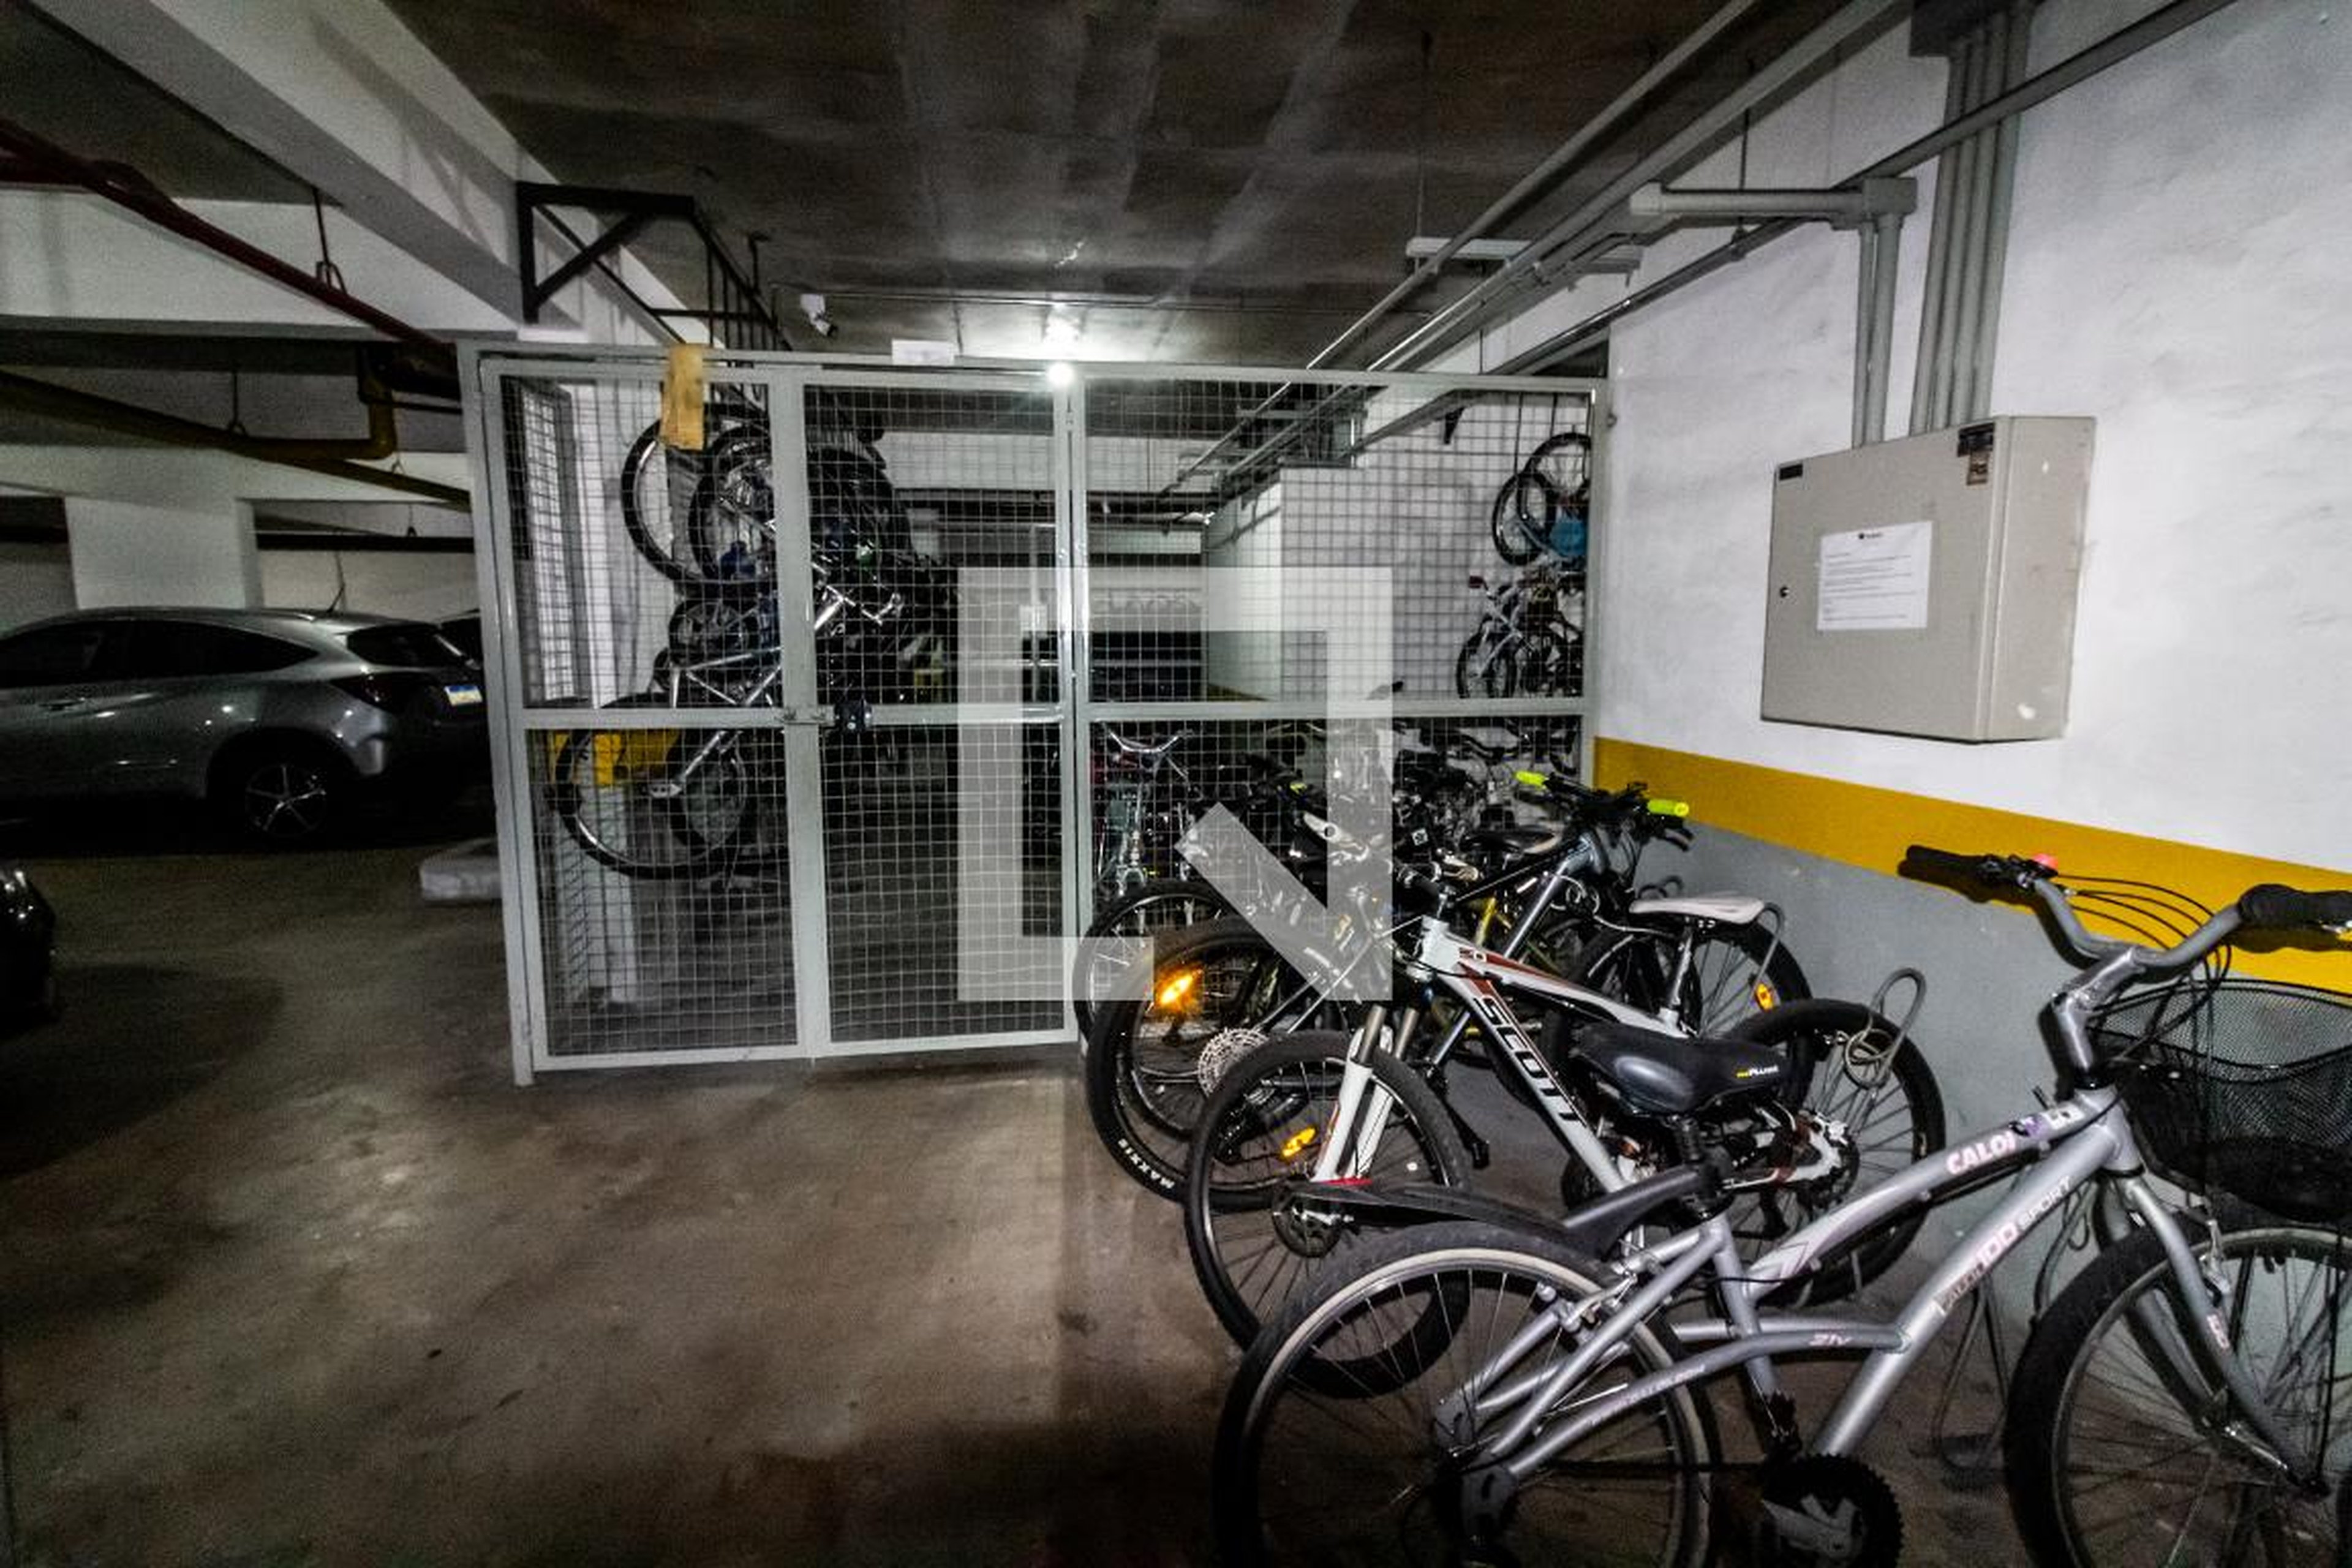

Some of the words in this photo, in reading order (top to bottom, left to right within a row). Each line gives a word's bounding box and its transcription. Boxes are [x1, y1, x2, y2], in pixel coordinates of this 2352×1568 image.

[1473, 997, 1587, 1128] SCOTT
[1947, 1130, 2016, 1174] CALOI
[2018, 1175, 2070, 1229] SPORT
